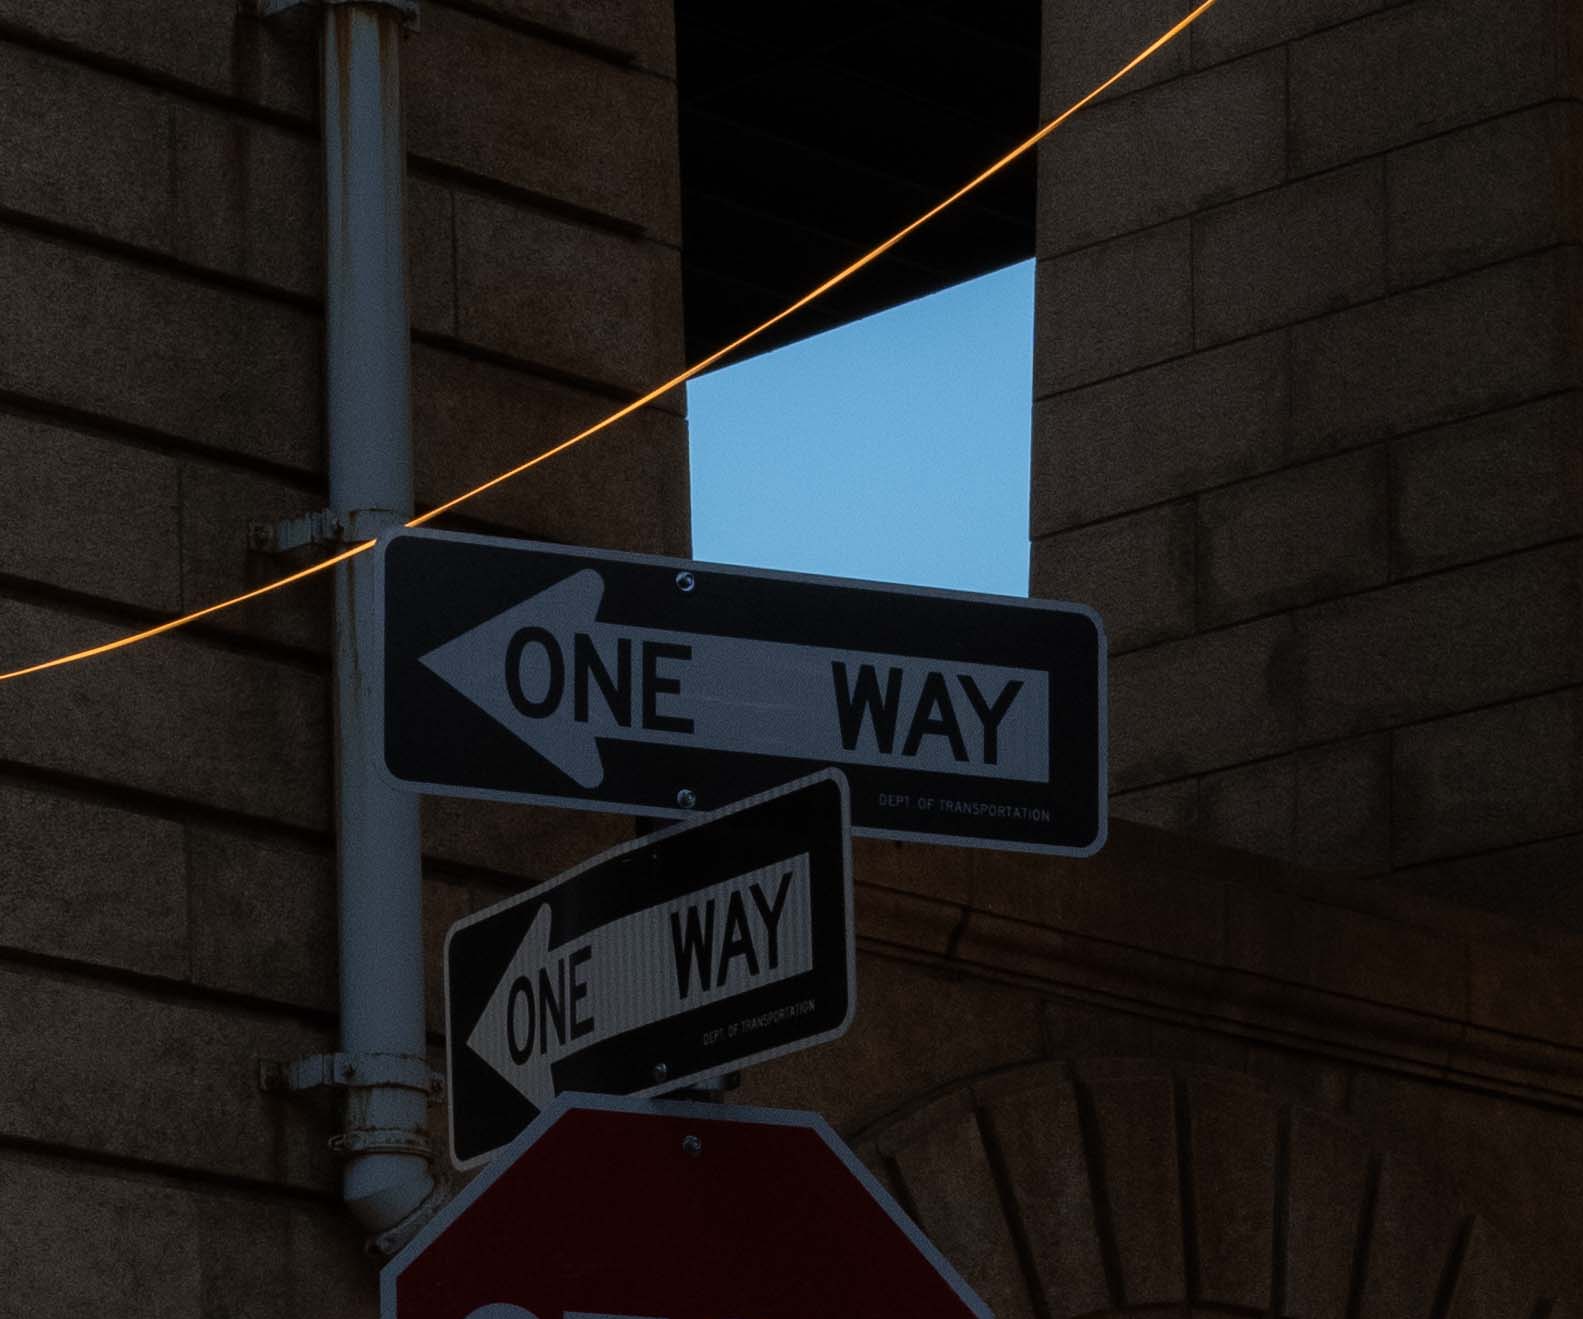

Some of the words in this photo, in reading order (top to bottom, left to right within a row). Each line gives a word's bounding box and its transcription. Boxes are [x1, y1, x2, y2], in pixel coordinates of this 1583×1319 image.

[505, 626, 695, 735] ONE
[830, 660, 1024, 766] WAY
[917, 798, 935, 811] OF
[940, 799, 1051, 823] TRANSPORTATION
[506, 945, 595, 1066] ONE
[670, 872, 793, 1000] WAY
[741, 999, 816, 1033] TRANSPORTATION
